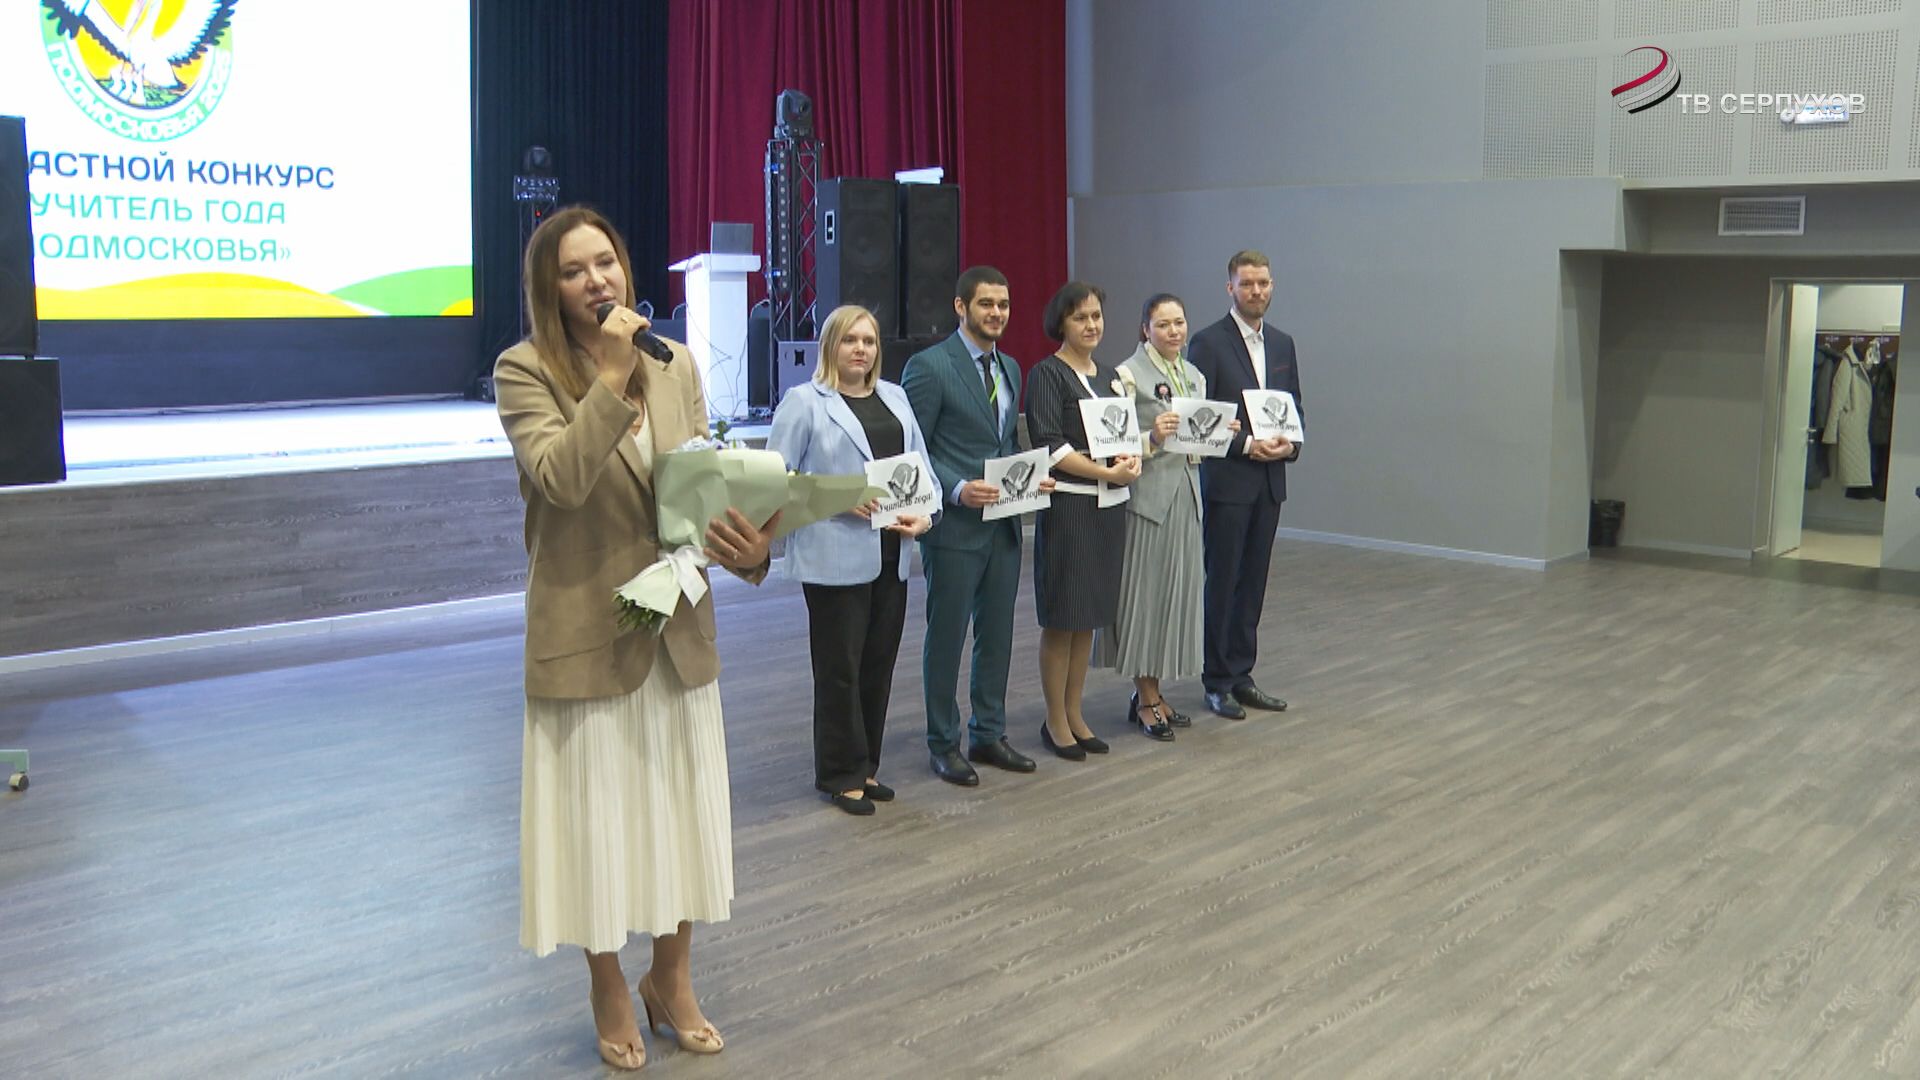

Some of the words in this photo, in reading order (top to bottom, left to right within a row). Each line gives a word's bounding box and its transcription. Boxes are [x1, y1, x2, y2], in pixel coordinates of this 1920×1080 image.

[29, 150, 174, 183] АСТНОЙ
[187, 160, 334, 189] КОНКУРС
[31, 192, 192, 221] УЧИТЕЛЬ
[205, 200, 286, 225] ГОДА
[38, 233, 291, 262] ОДМОСКОВЬЯ»
